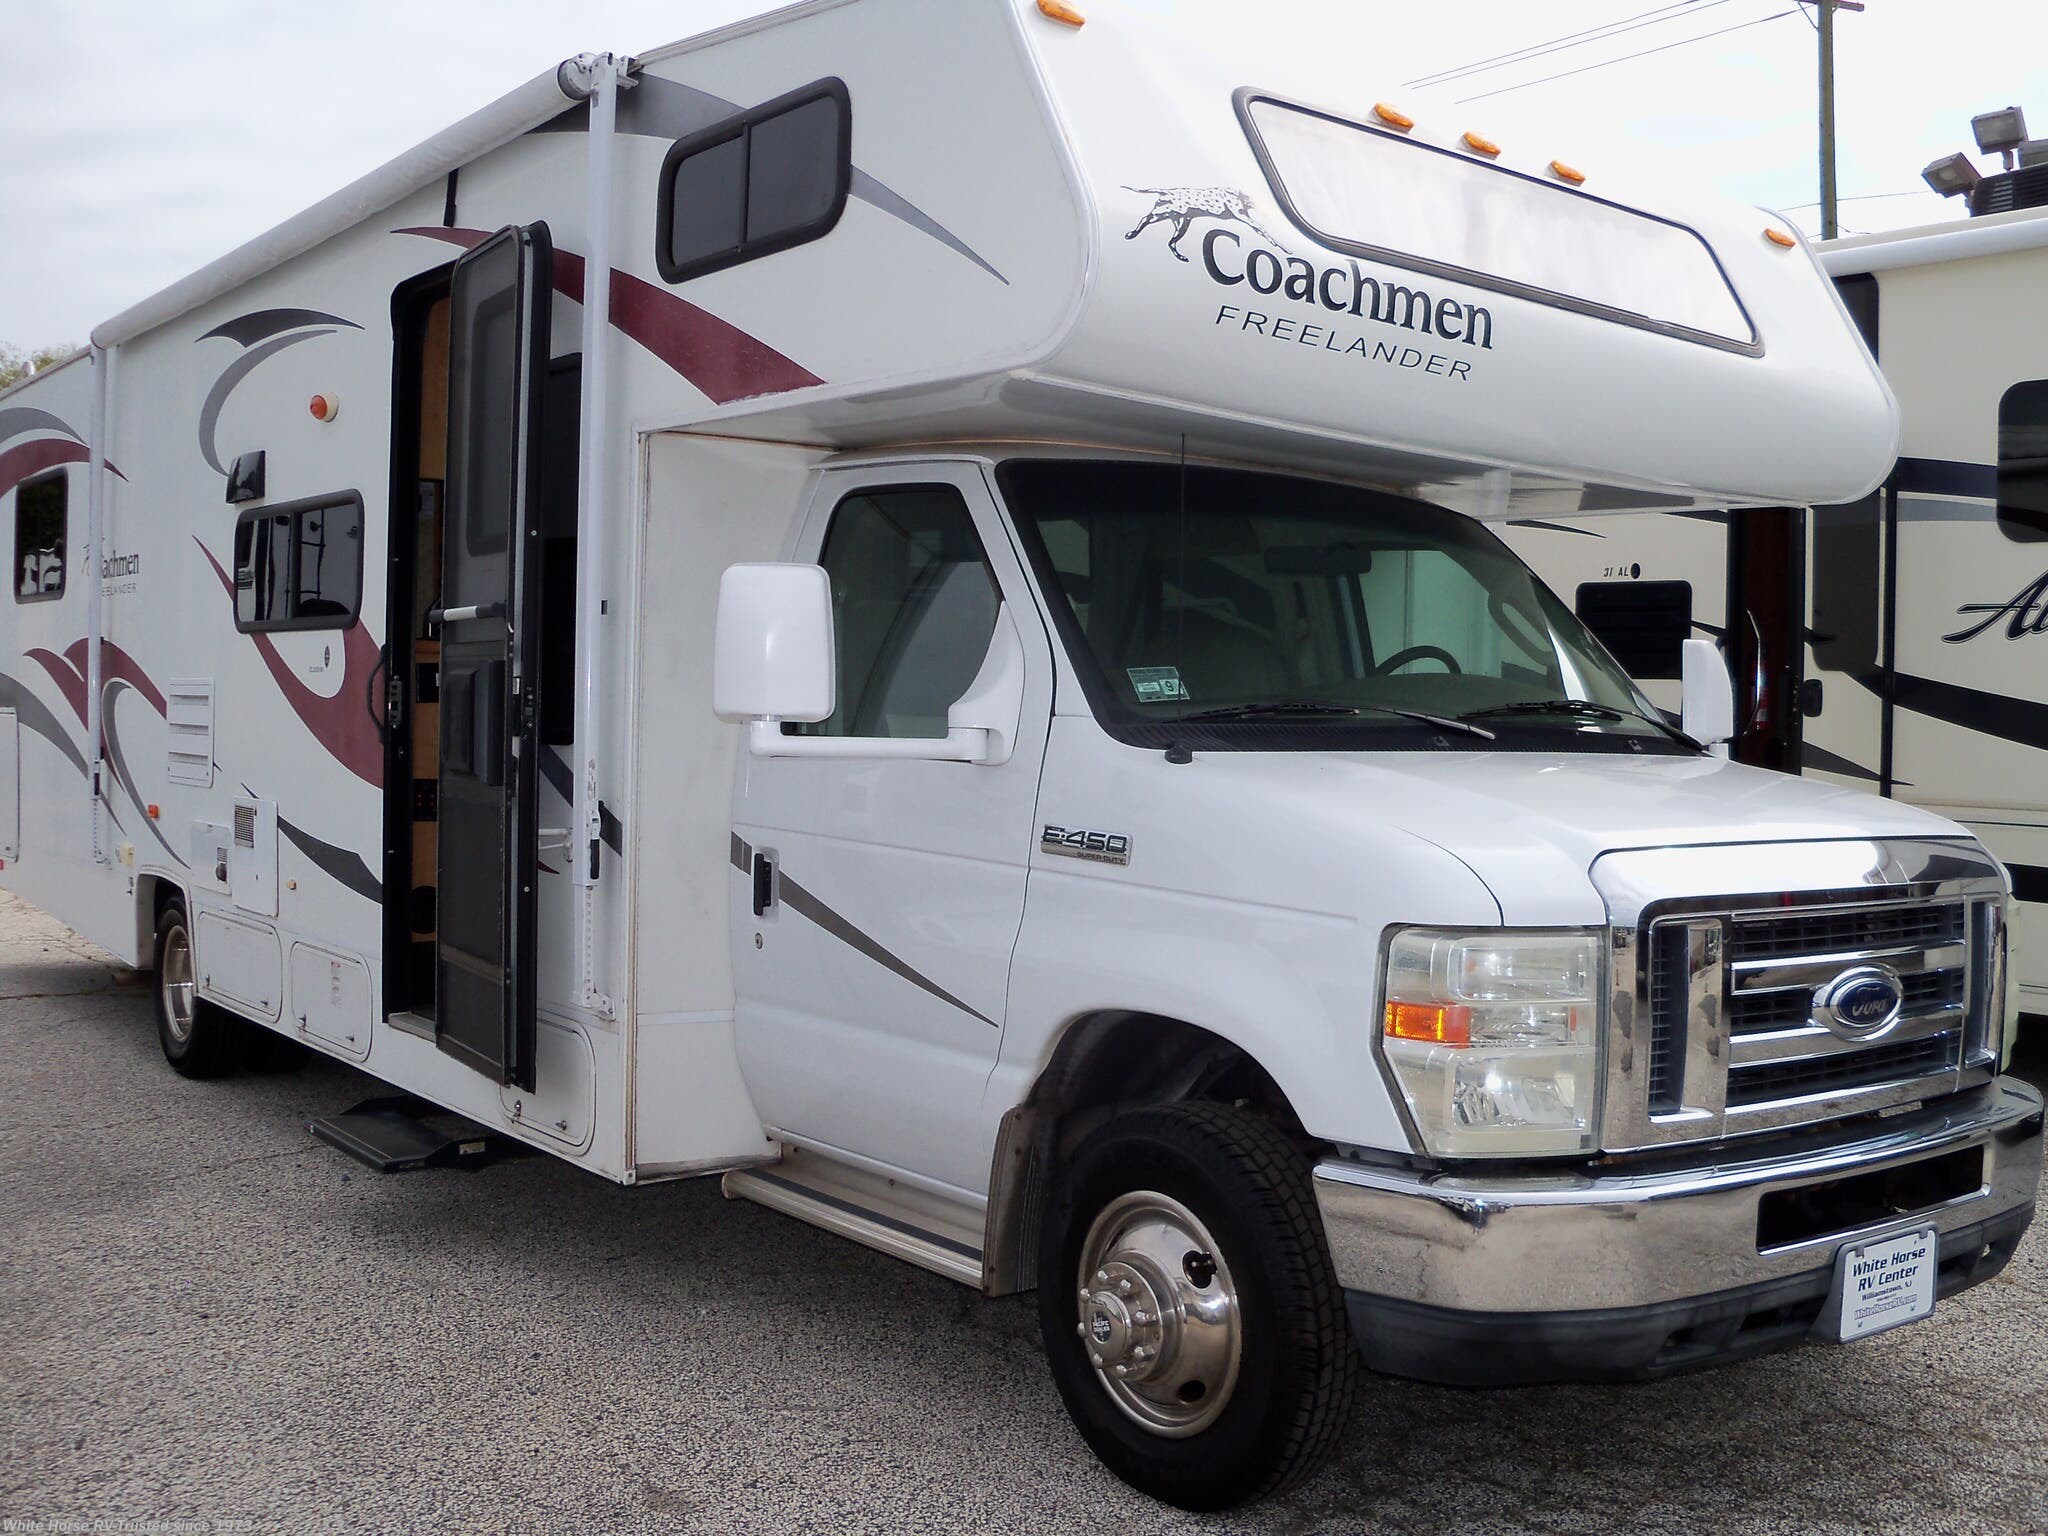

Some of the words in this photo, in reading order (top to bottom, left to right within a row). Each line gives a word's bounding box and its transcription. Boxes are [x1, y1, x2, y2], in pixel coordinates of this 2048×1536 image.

[1202, 229, 1492, 350] Coachmen
[1215, 304, 1472, 381] FREELANDER
[1041, 824, 1129, 854] E-450
[1852, 1259, 1888, 1277] White
[1891, 1247, 1926, 1266] Horse
[1858, 1274, 1876, 1292] RV
[1878, 1265, 1919, 1286] Center
